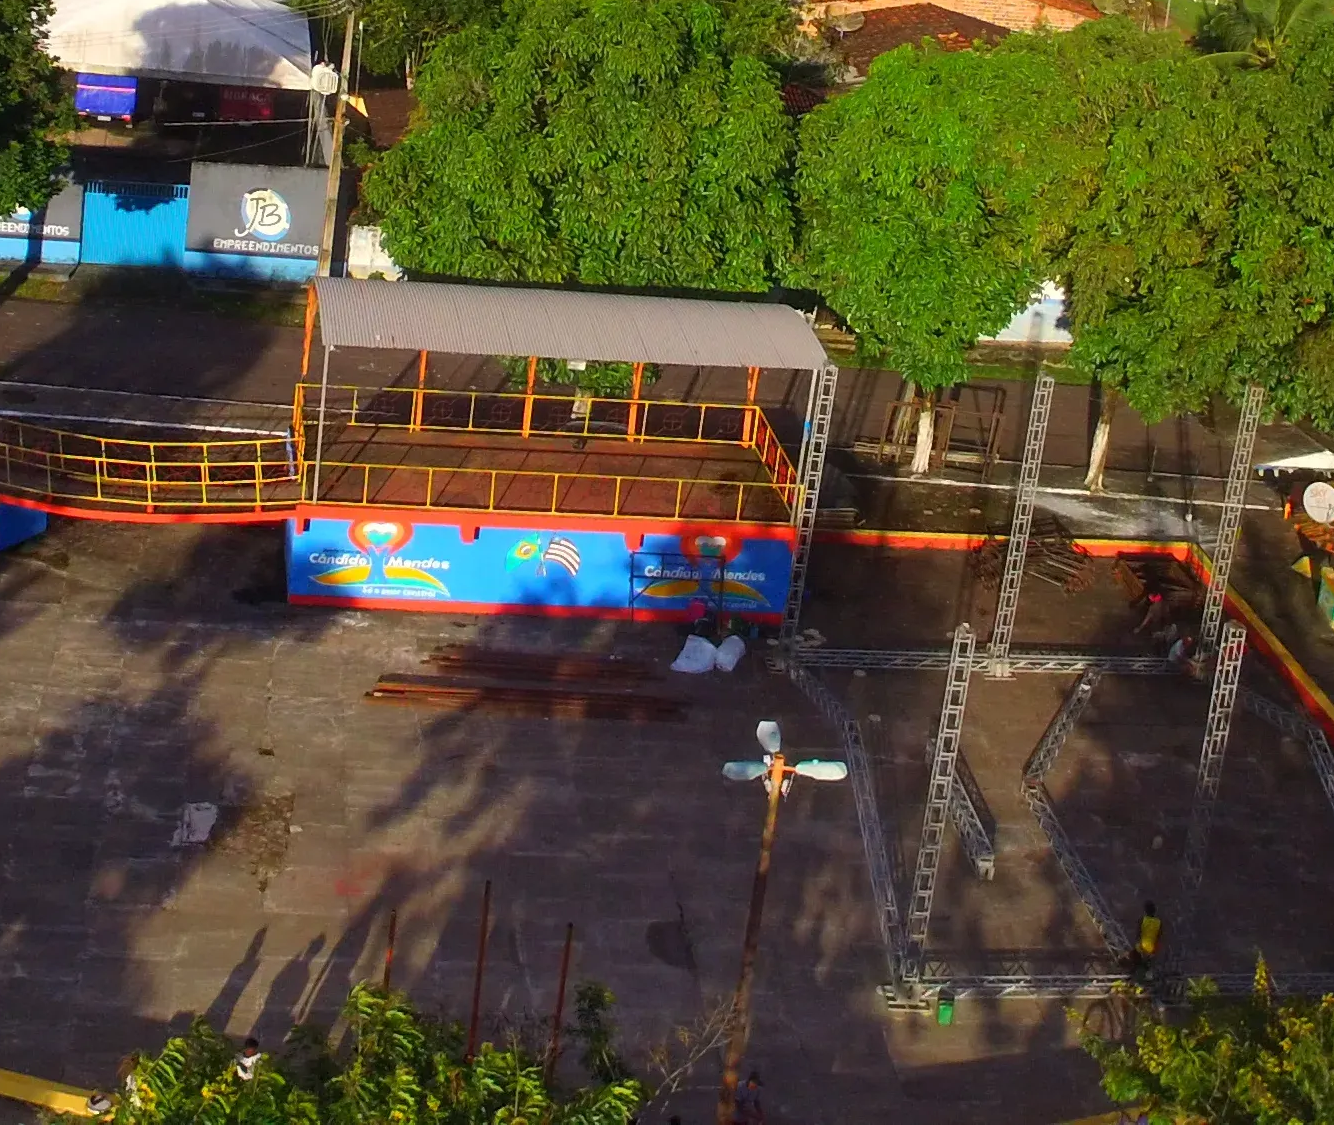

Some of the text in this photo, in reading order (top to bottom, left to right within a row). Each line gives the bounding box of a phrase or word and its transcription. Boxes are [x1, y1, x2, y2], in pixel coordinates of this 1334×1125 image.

[234, 197, 283, 238] JB
[213, 238, 320, 256] EMPREENDIMENTOS
[309, 552, 450, 570] Cândido Mendes
